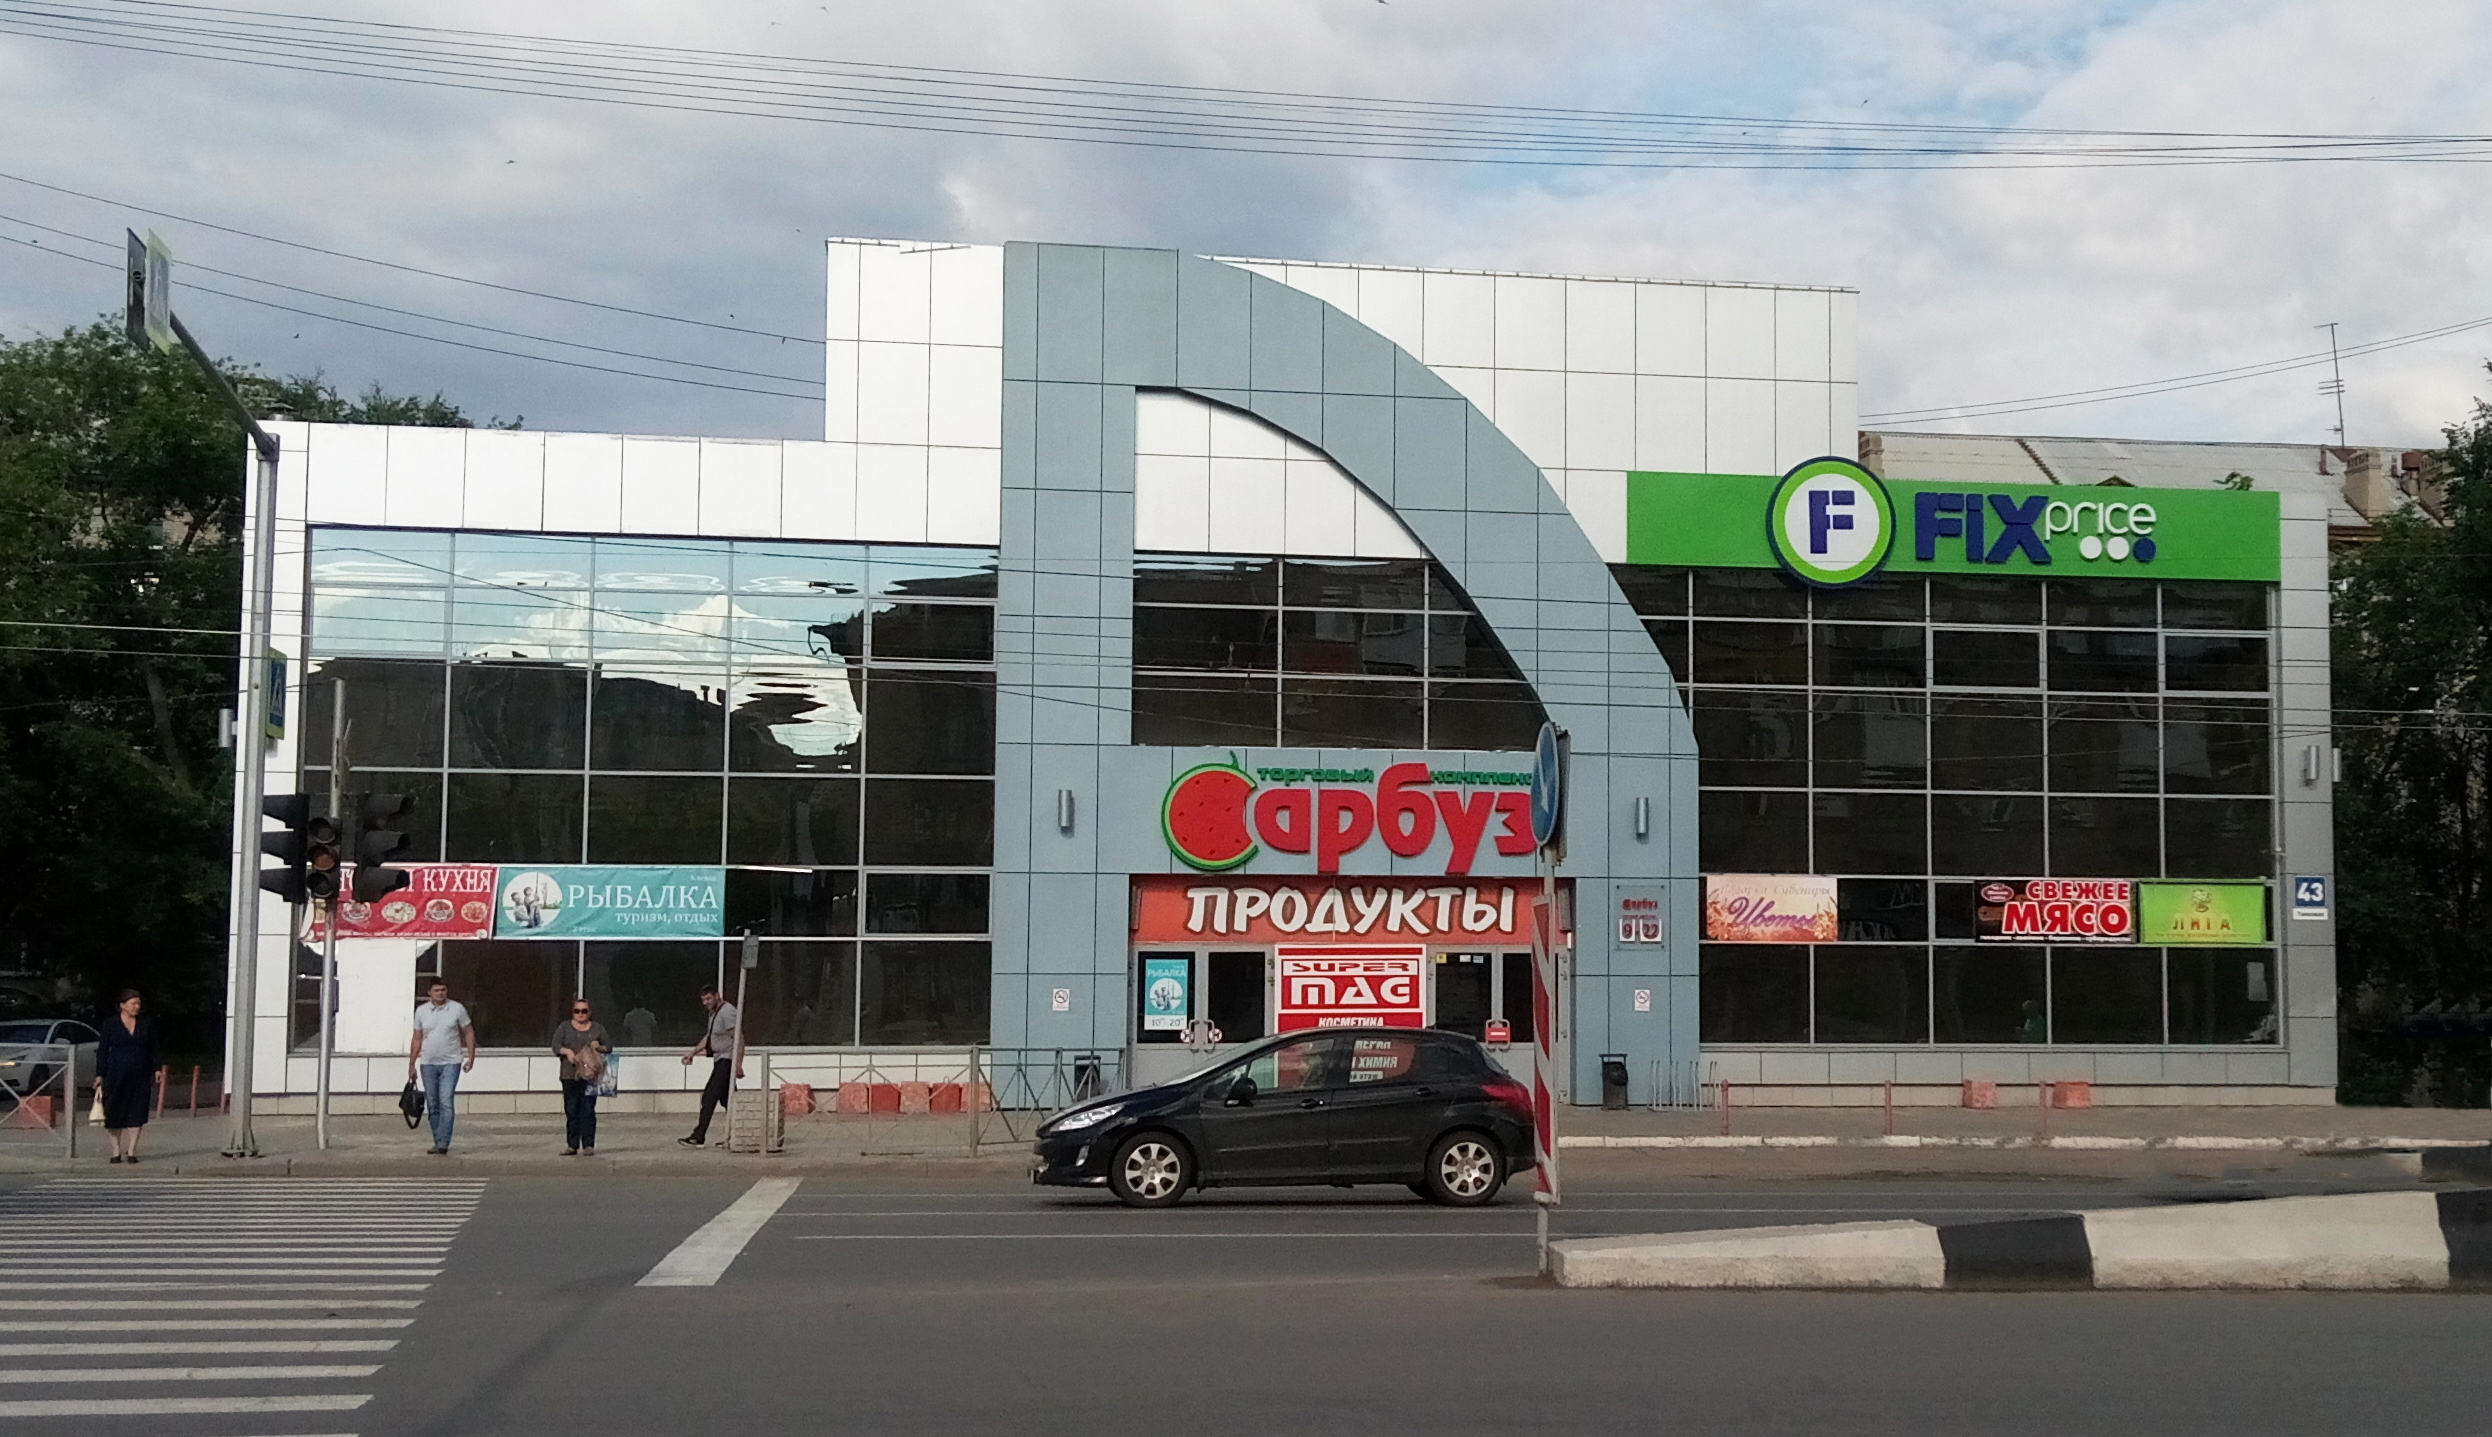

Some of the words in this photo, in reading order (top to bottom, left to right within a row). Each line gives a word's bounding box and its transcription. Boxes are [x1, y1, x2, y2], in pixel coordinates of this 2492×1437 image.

[1808, 490, 1856, 555] F
[2044, 500, 2157, 541] price
[423, 868, 493, 893] КУХНЯ
[2026, 881, 2131, 900] СВЕЖЕЕ
[2297, 882, 2324, 902] 43
[567, 884, 719, 909] РЫБАЛКА
[615, 911, 671, 926] туризм,
[674, 912, 718, 924] отдых
[1186, 886, 1515, 935] ПРОДУКТЫ
[1728, 896, 1817, 935] Цветы
[2002, 902, 2131, 935] МЯСО
[1292, 962, 1410, 973] SUPER
[1290, 977, 1411, 1005] MAG
[1357, 1056, 1398, 1068] ХИМИЯ
